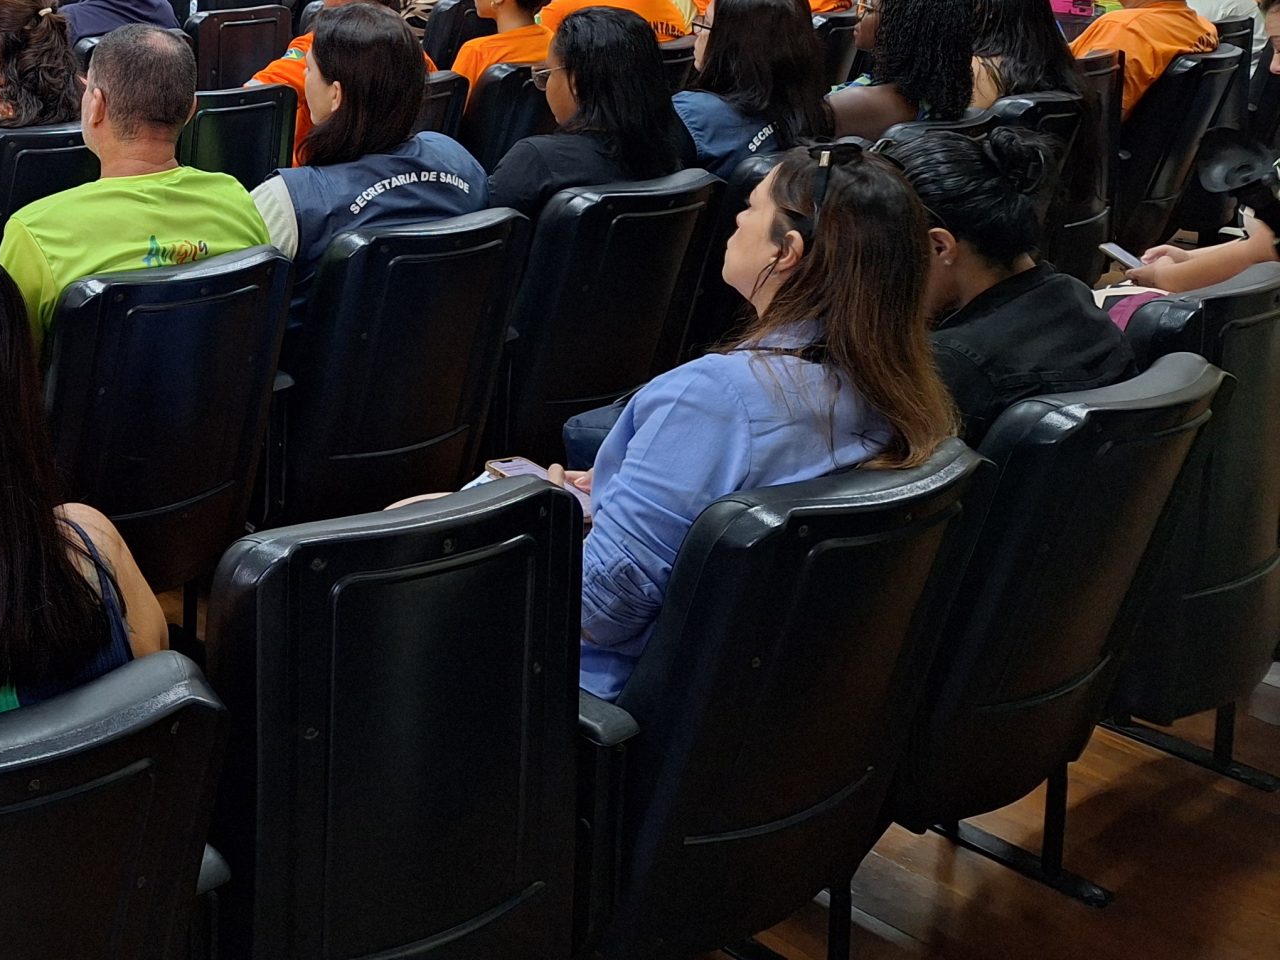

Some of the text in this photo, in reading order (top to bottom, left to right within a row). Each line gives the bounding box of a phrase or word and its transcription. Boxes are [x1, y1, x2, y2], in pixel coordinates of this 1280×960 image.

[350, 171, 470, 215] SECRETARIA DE SAÚDE
